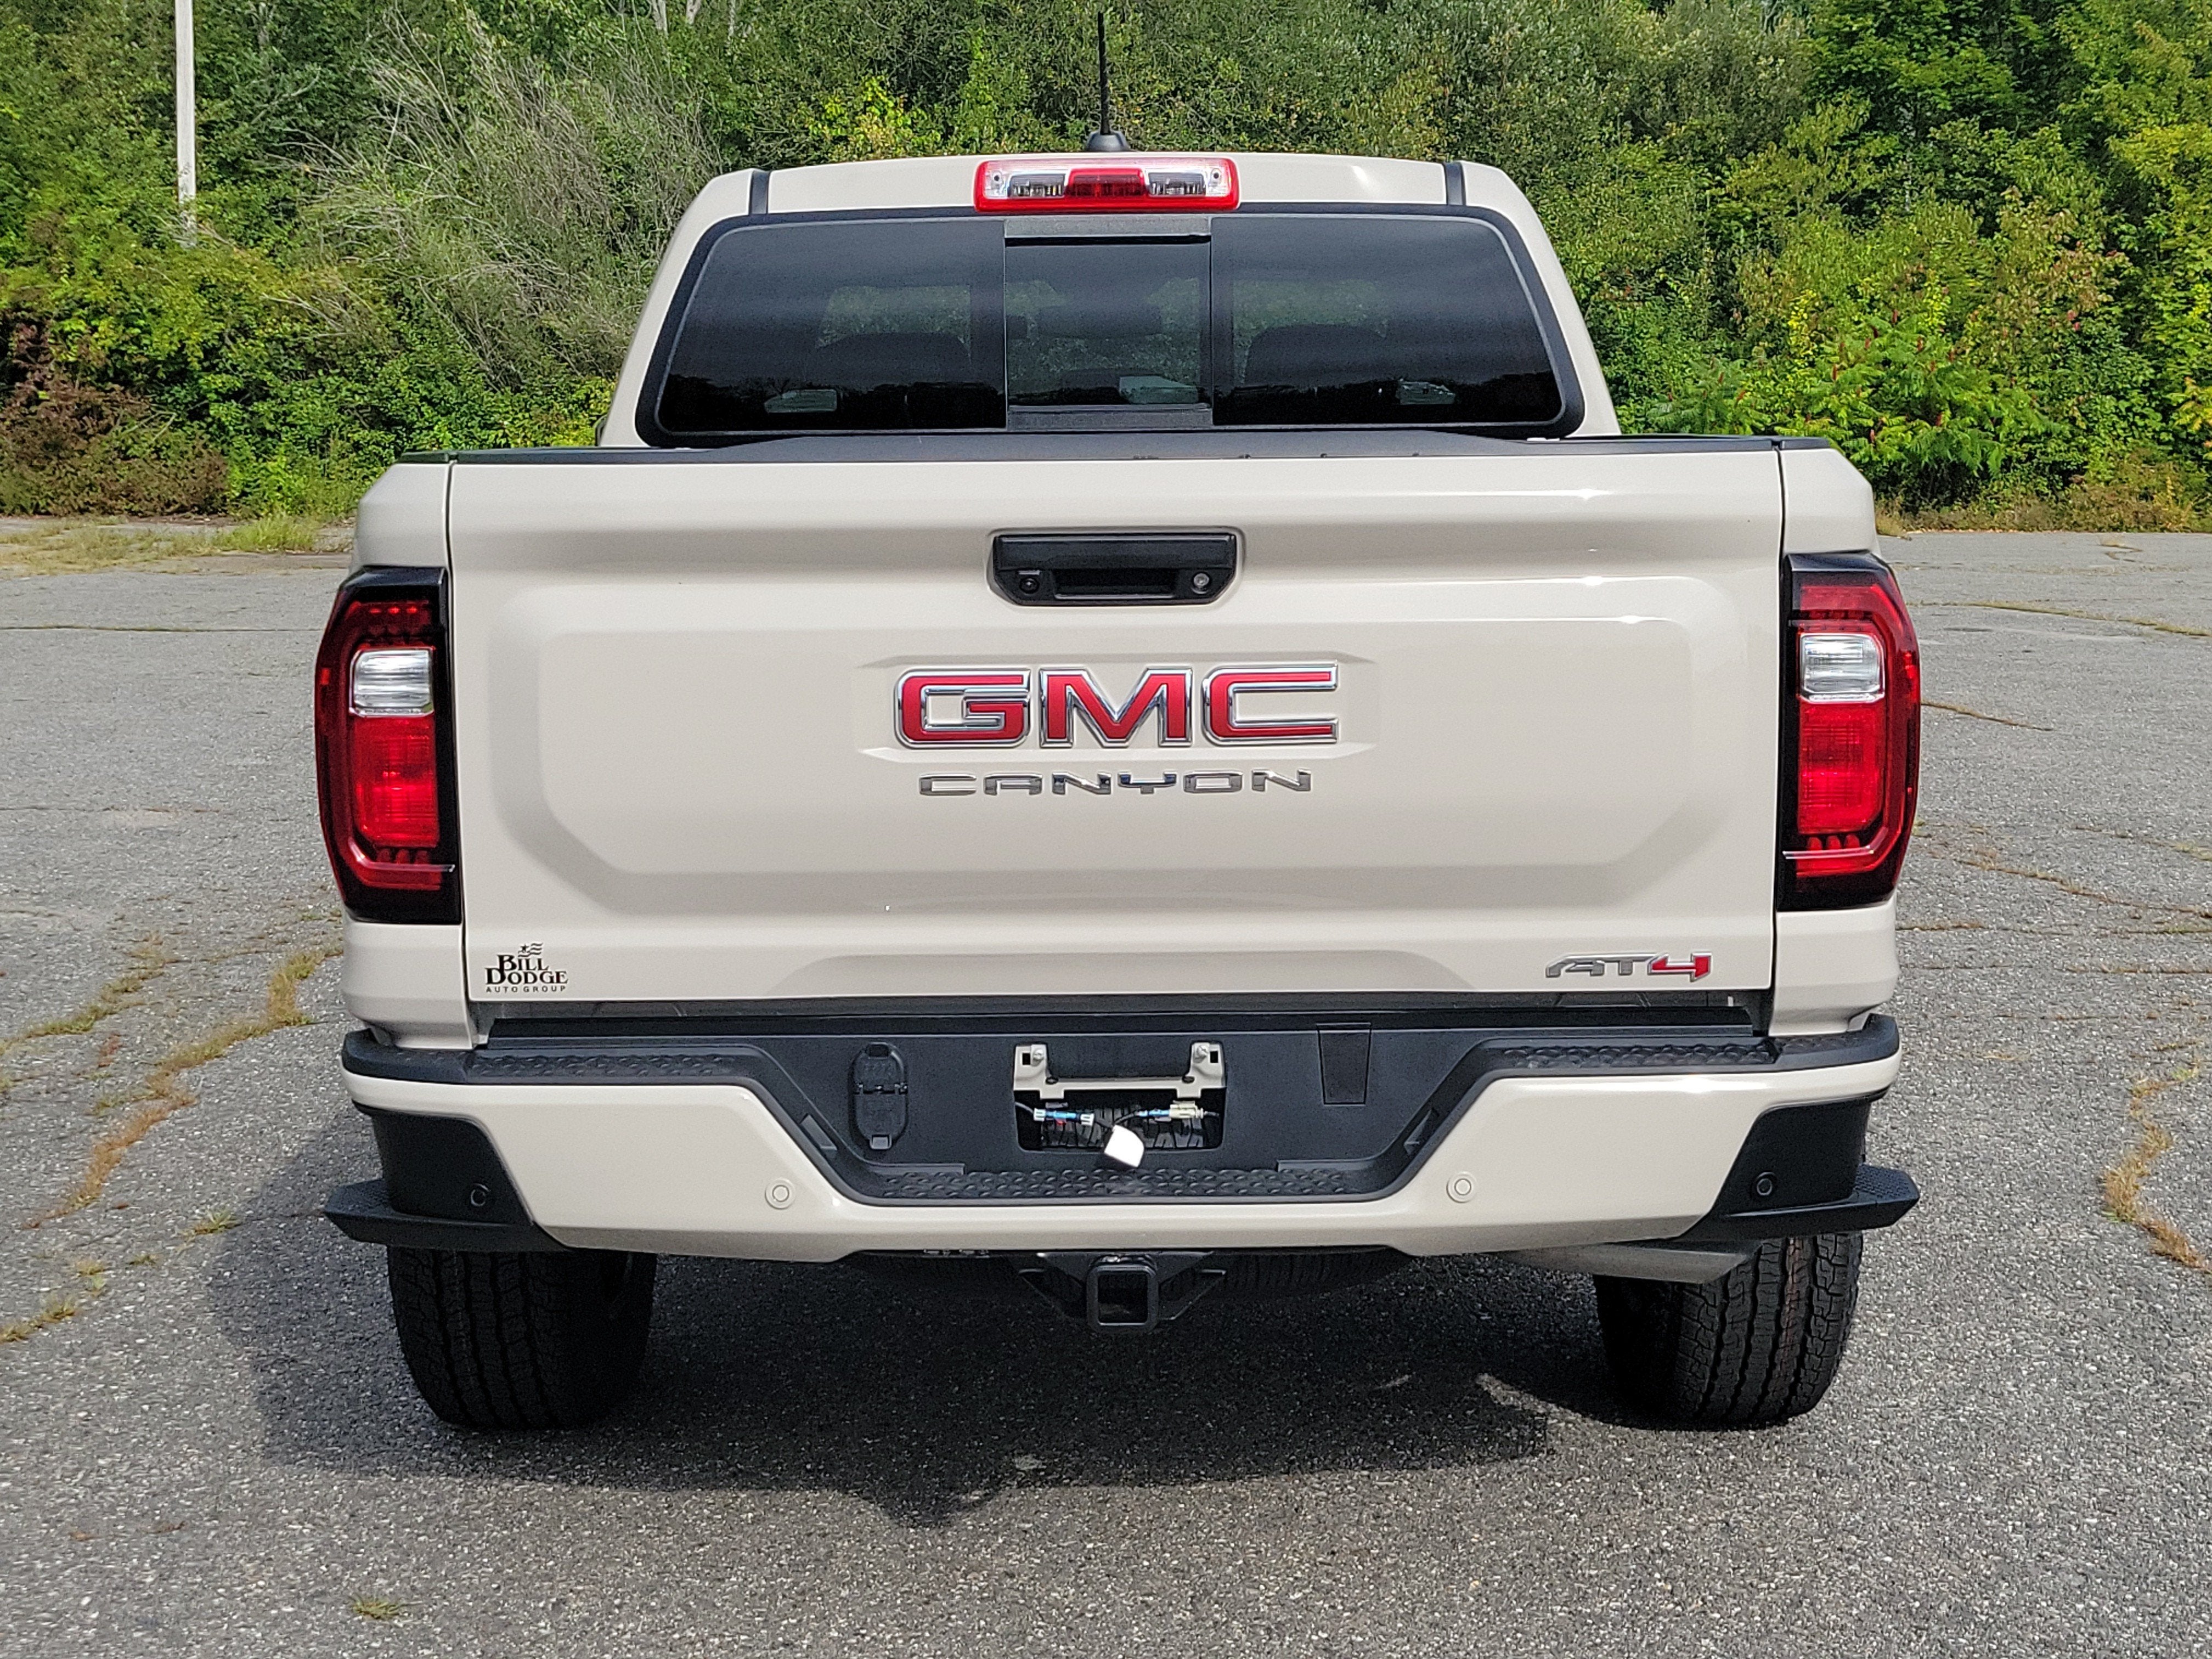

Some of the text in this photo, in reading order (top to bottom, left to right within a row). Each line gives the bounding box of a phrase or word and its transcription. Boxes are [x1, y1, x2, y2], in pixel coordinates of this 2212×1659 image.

[895, 662, 1338, 748] GMC
[919, 770, 1312, 795] CANYON
[497, 955, 549, 971] BILL
[1545, 952, 1712, 982] AT4
[486, 968, 568, 985] DODGE
